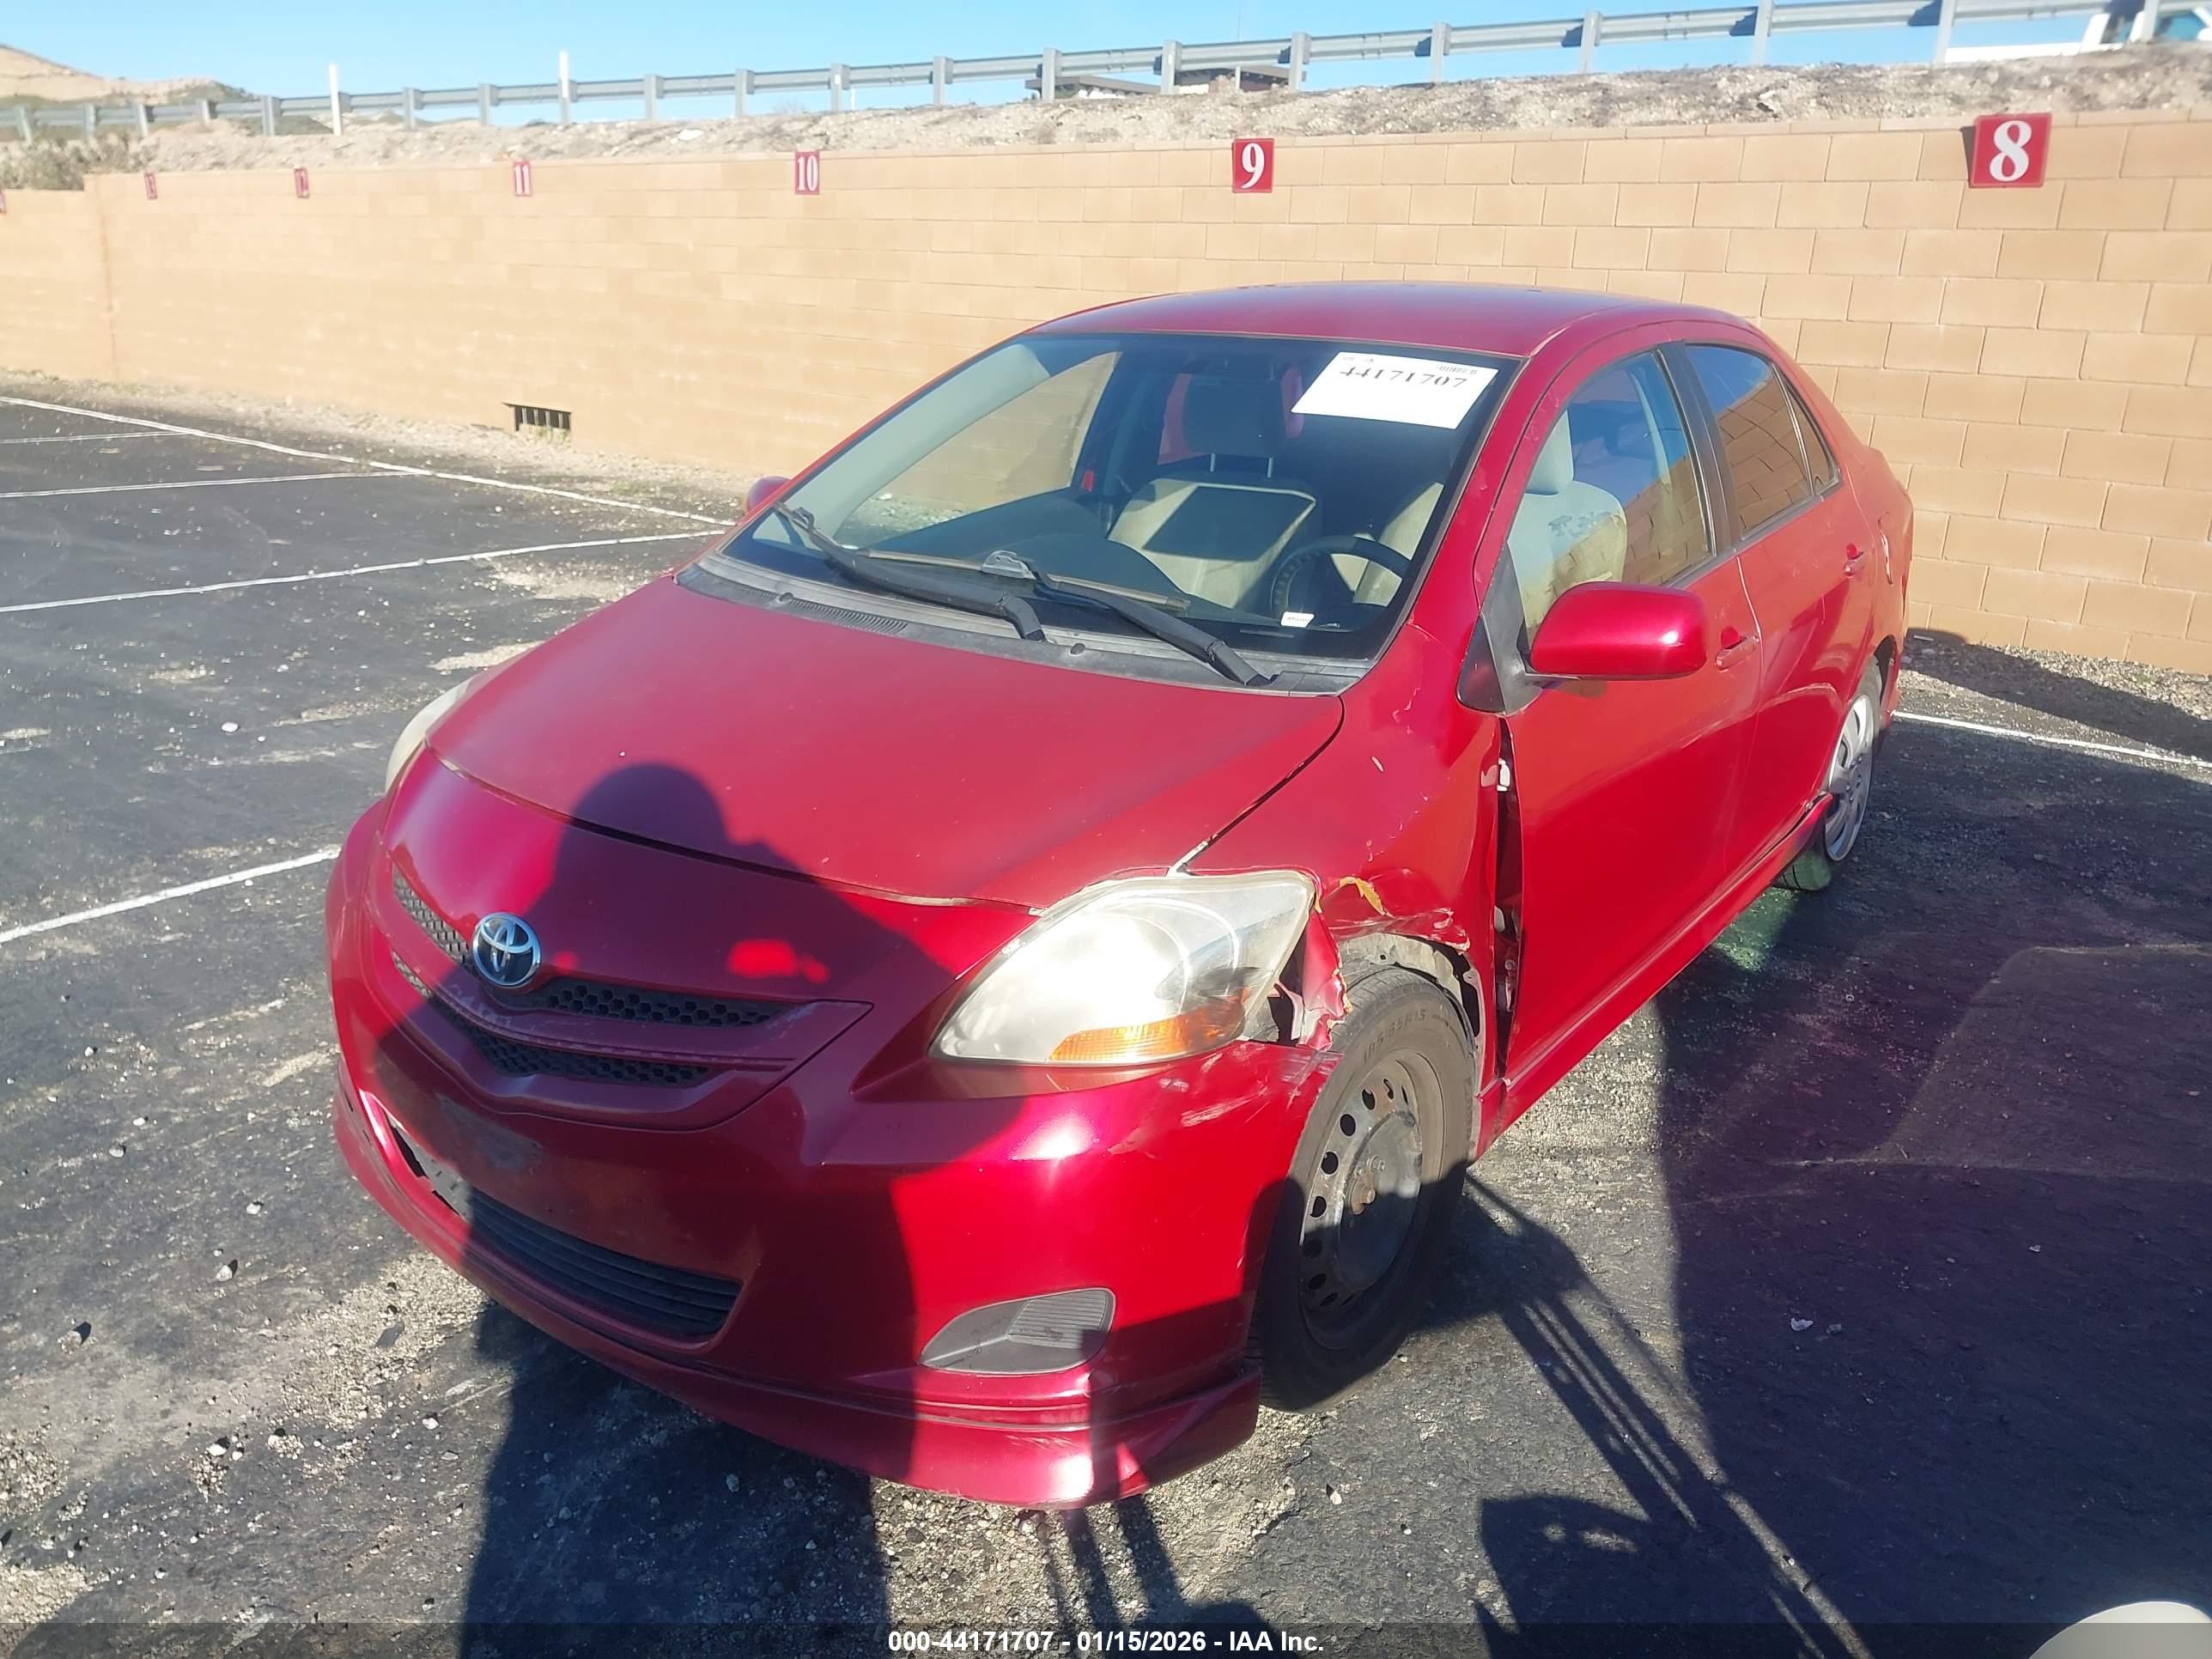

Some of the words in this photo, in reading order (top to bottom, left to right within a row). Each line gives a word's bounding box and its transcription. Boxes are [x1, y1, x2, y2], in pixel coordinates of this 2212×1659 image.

[1241, 143, 1265, 189] 9
[1989, 119, 2033, 182] 8
[514, 164, 531, 195] 11
[797, 155, 818, 191] 10
[1340, 366, 1468, 388] 44171707
